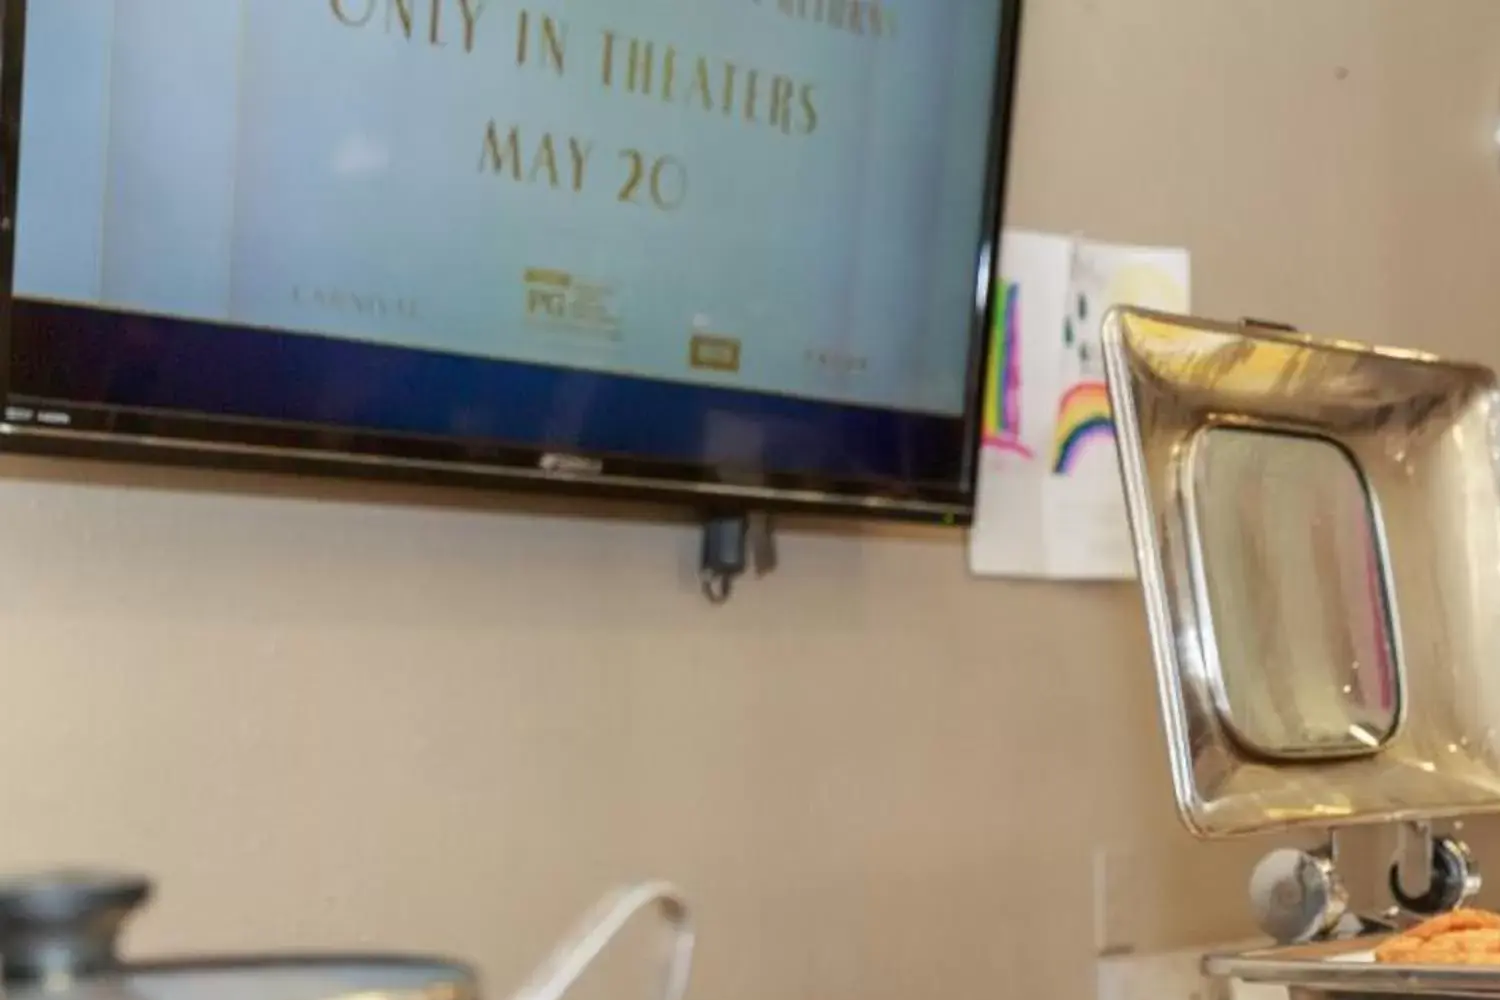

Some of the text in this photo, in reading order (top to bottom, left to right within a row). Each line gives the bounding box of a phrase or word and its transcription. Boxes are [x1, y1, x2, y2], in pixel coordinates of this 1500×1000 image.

[329, 0, 819, 135] ONLY IN THEATERS
[477, 116, 688, 212] MAY 20
